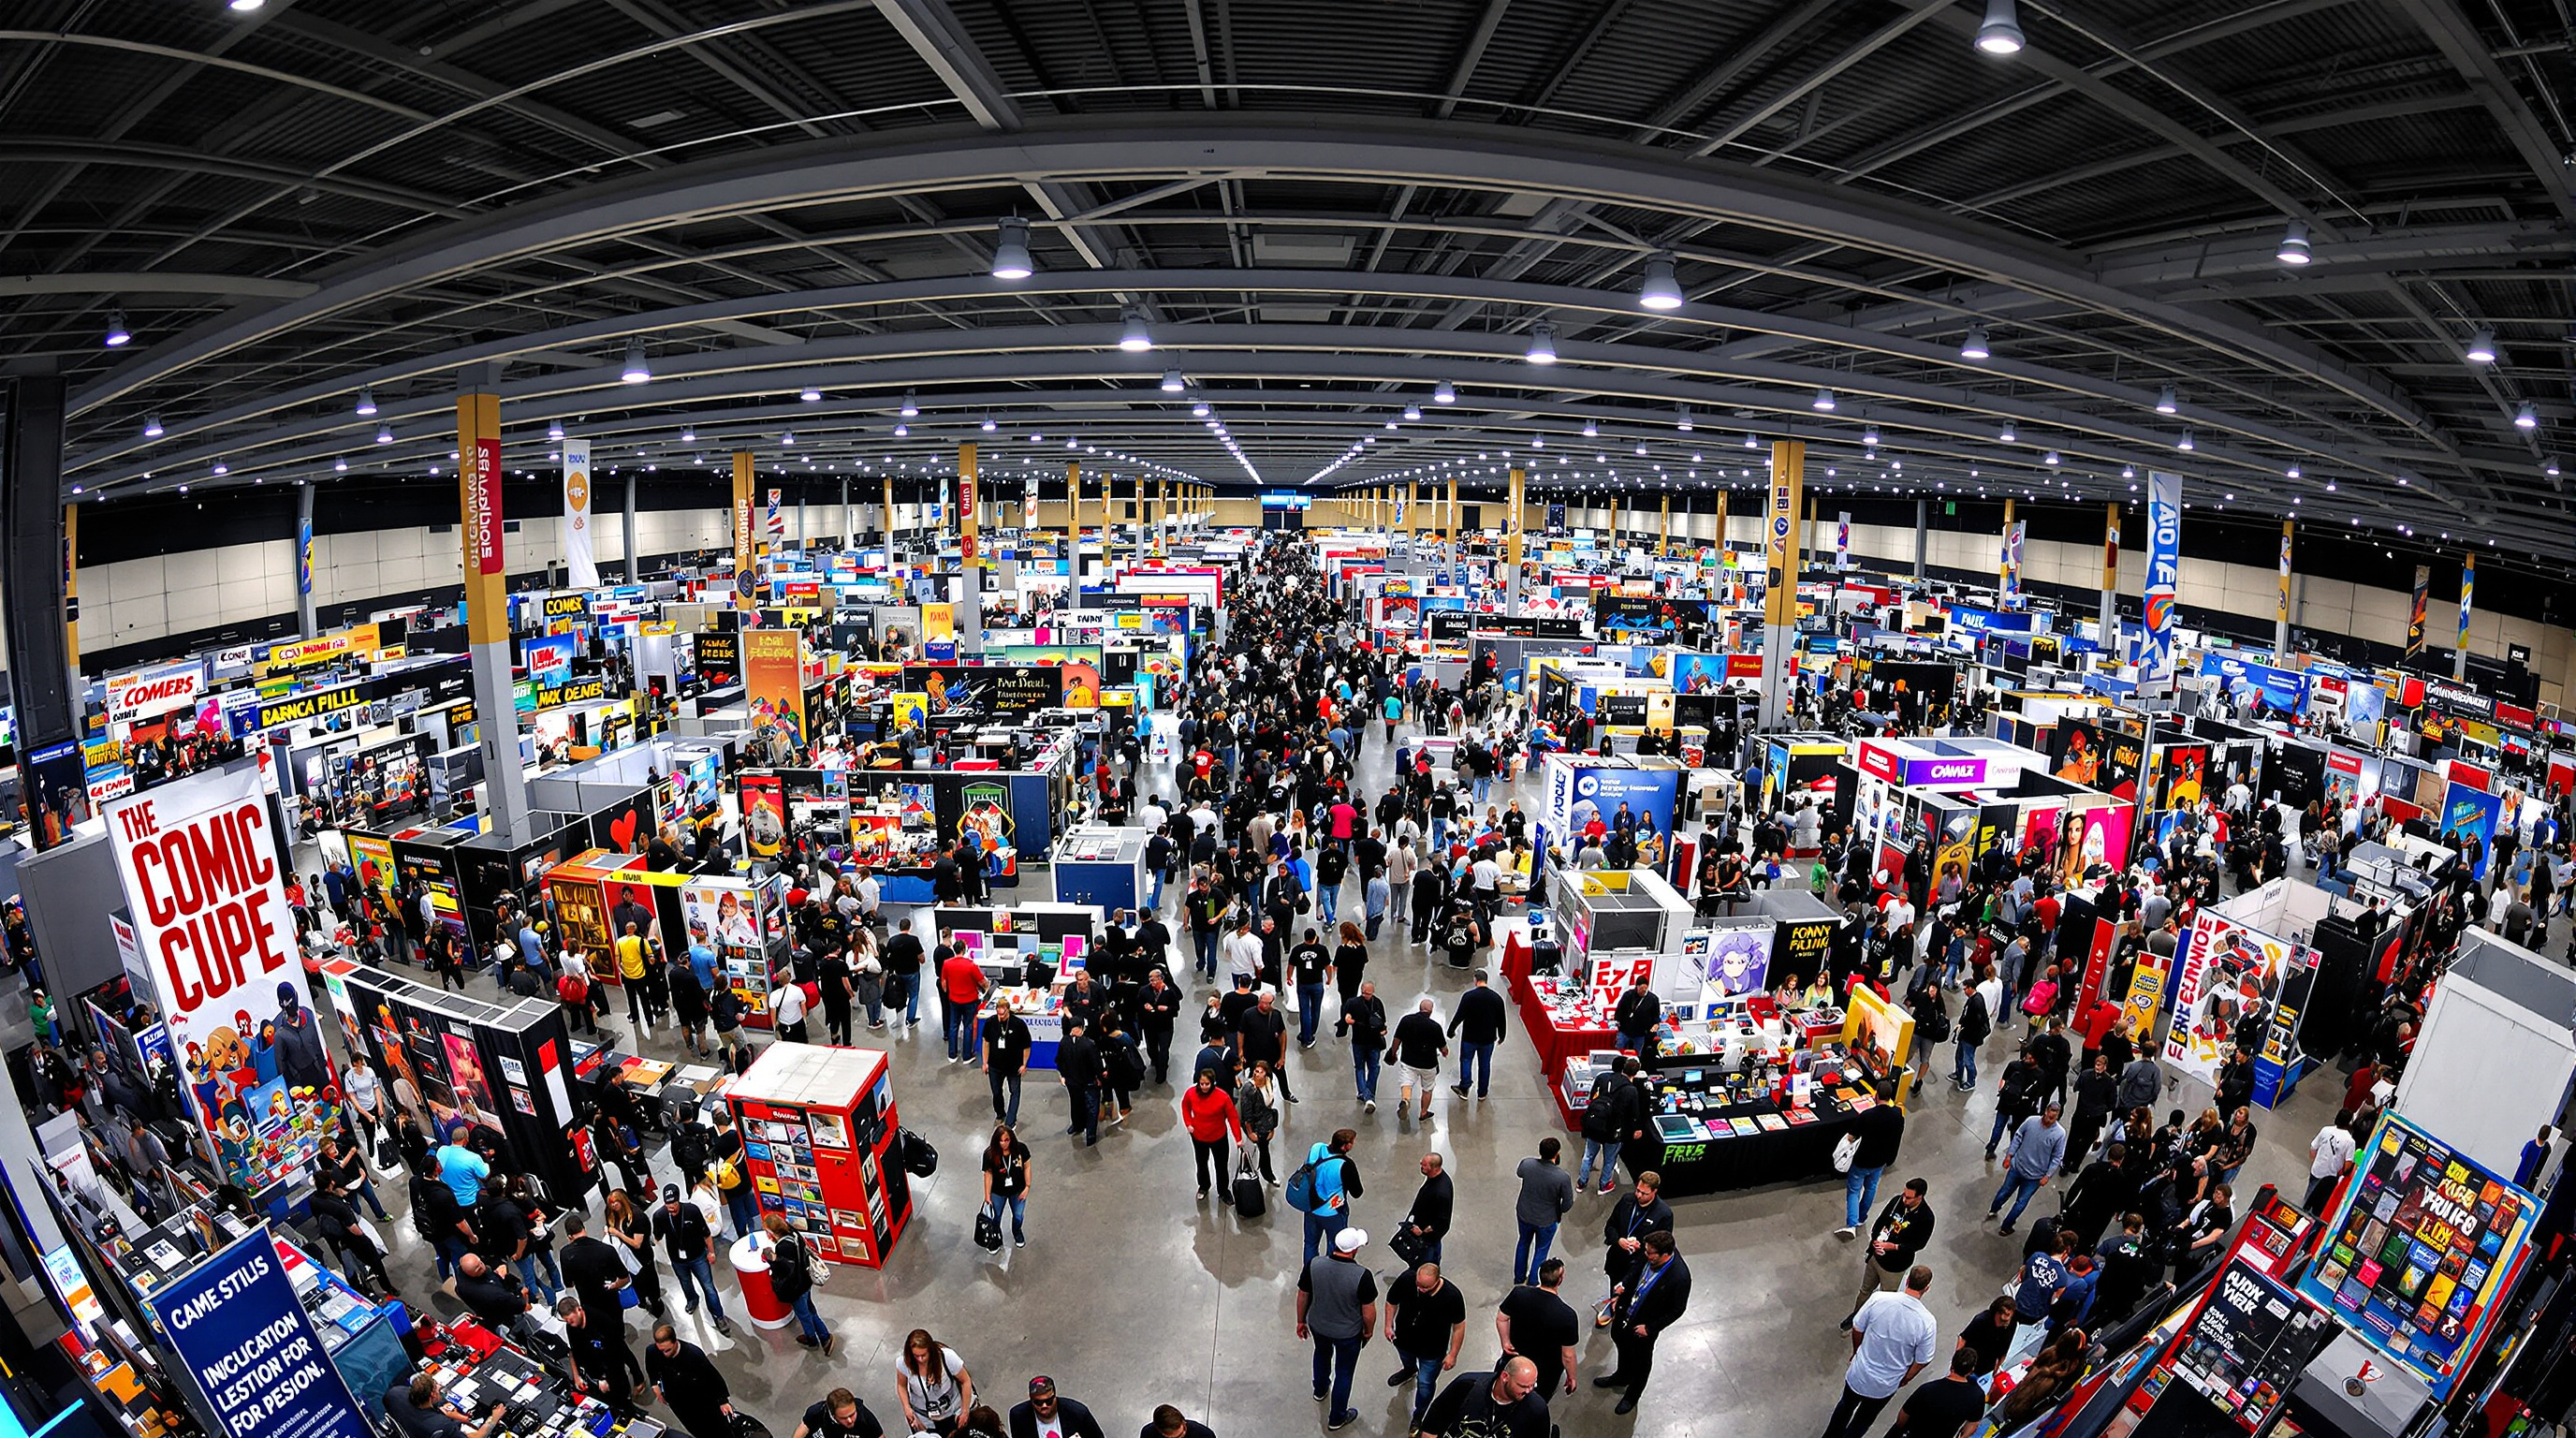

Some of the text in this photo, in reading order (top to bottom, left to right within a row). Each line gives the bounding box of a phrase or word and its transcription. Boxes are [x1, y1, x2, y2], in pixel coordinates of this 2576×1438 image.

[118, 800, 160, 844] THE
[132, 803, 274, 928] COMIC
[159, 888, 286, 1013] CUPE
[170, 1287, 223, 1330] CAME
[216, 1336, 313, 1414] LESTION FOR
[229, 1403, 267, 1438] FOR
[262, 1360, 326, 1416] PESION.
